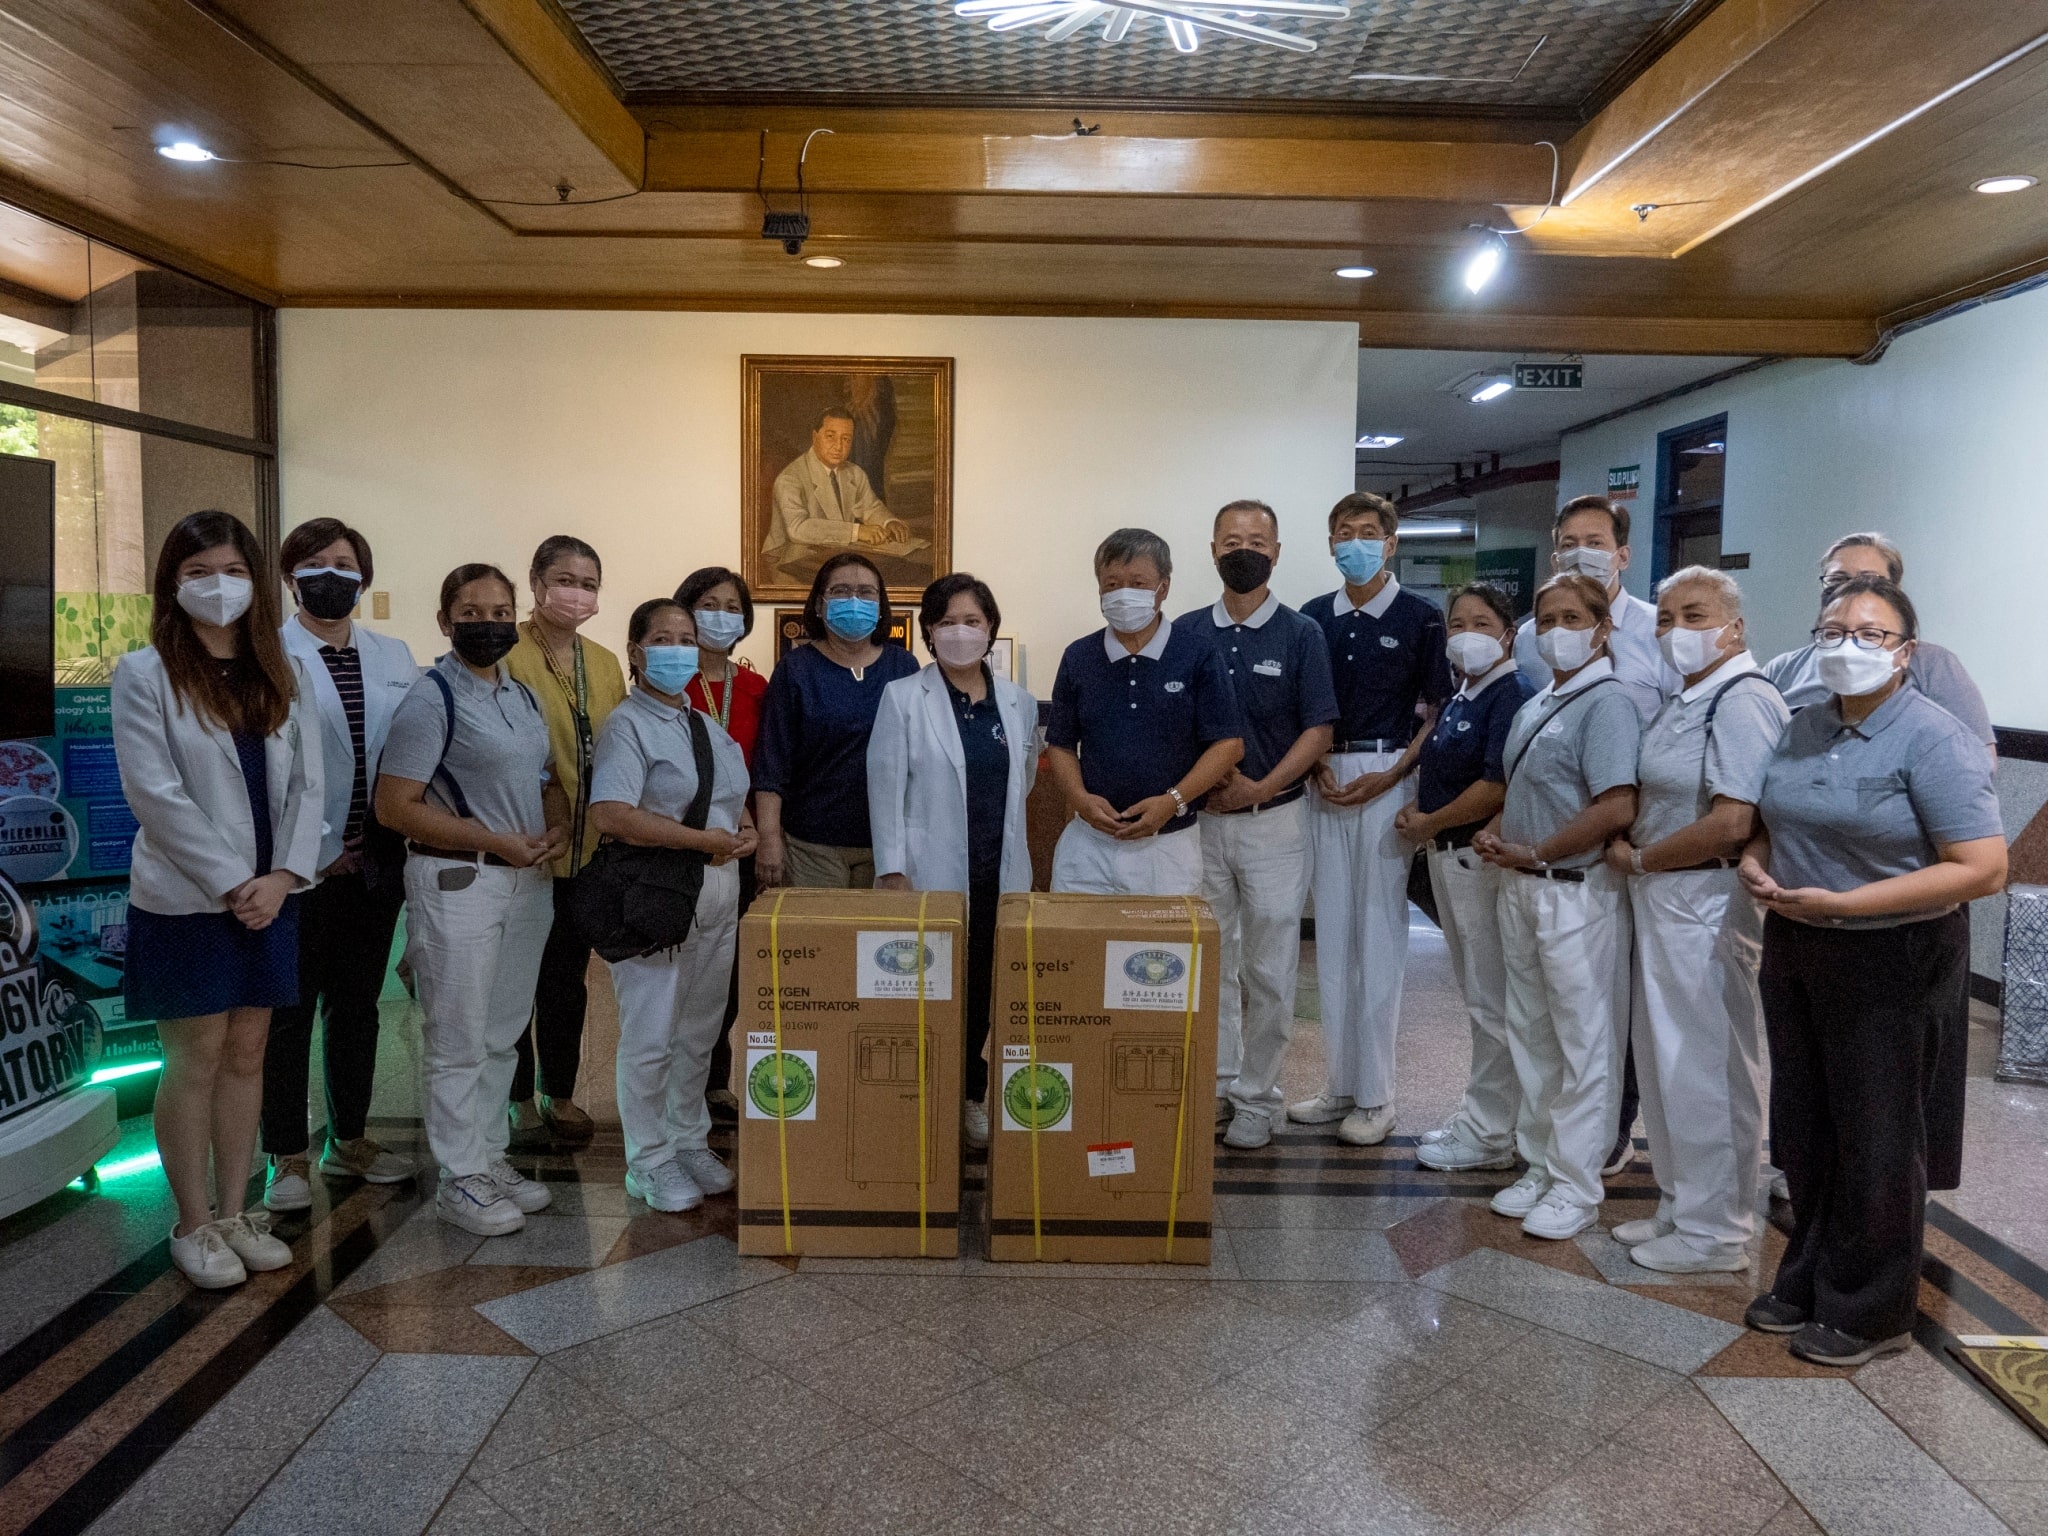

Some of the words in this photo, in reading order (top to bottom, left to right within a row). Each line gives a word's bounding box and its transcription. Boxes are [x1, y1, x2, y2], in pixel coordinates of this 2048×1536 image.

[1522, 368, 1575, 386] EXIT
[73, 695, 107, 704] QMMC
[54, 705, 85, 716] ology
[86, 705, 95, 714] &
[1010, 1001, 1062, 1012] OXGEN
[1010, 1015, 1112, 1026] COCENTRATOR
